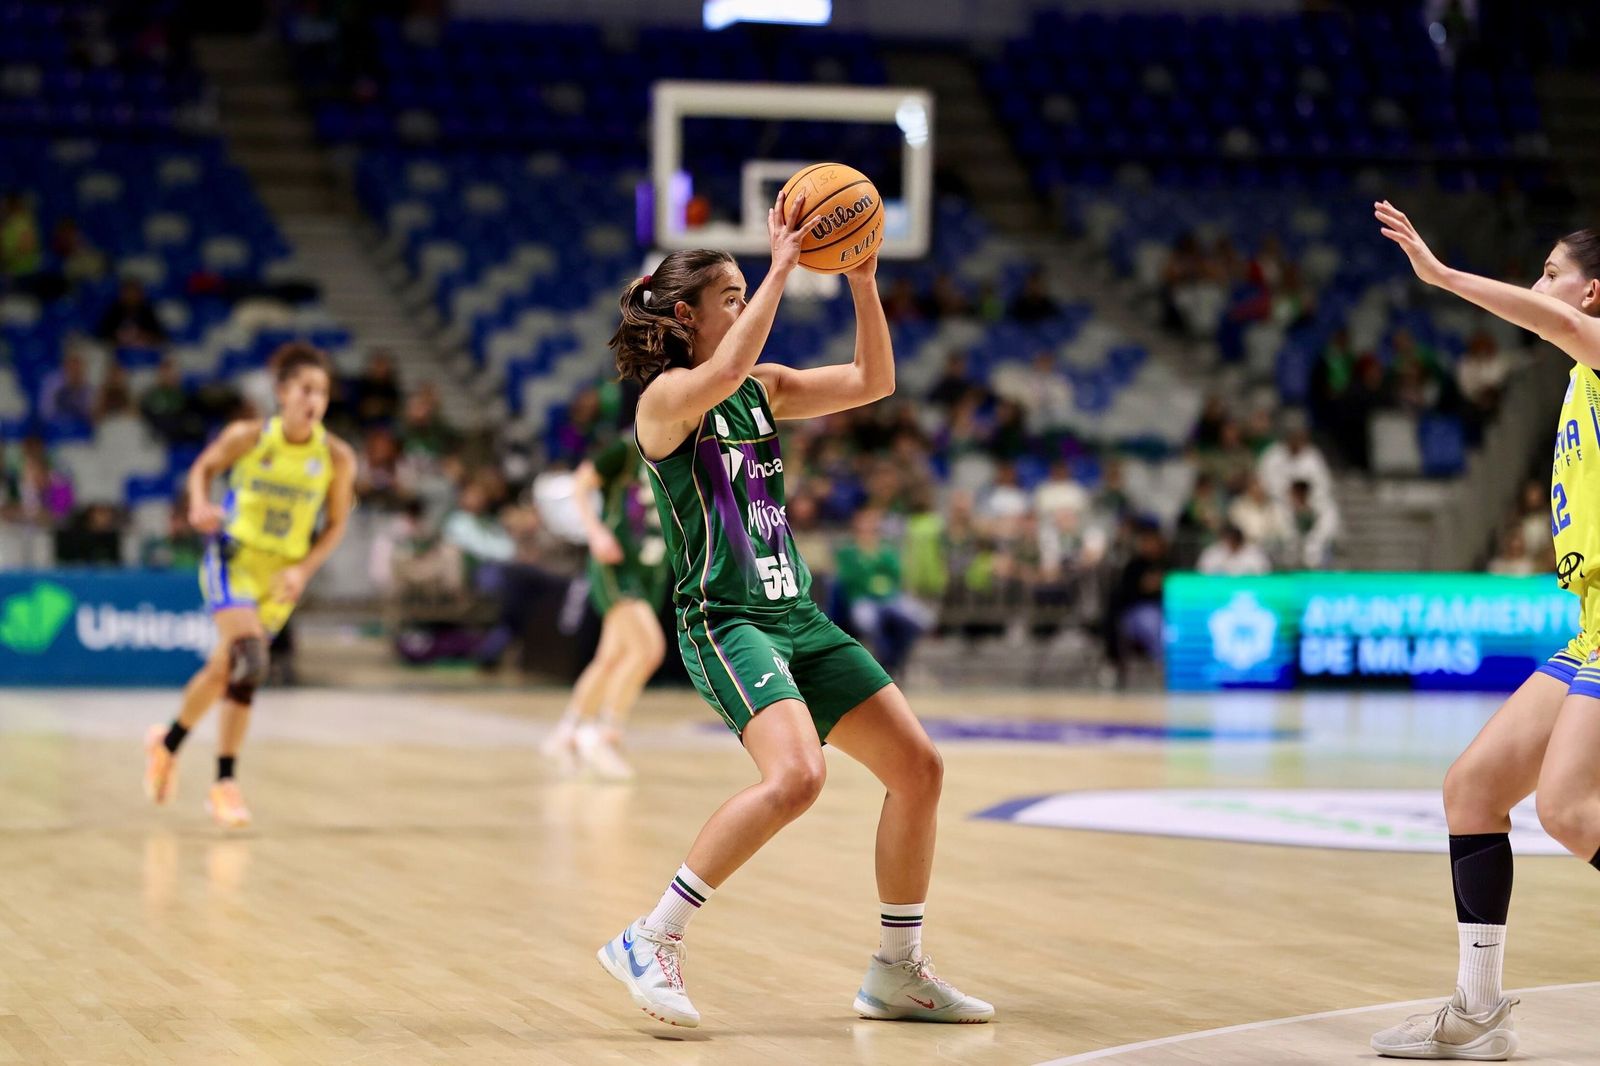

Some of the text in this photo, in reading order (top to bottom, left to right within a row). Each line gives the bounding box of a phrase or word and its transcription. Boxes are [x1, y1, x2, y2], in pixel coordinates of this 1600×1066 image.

[811, 195, 874, 240] Wilson
[756, 552, 798, 601] 55
[1299, 636, 1480, 676] DE MIJAS
